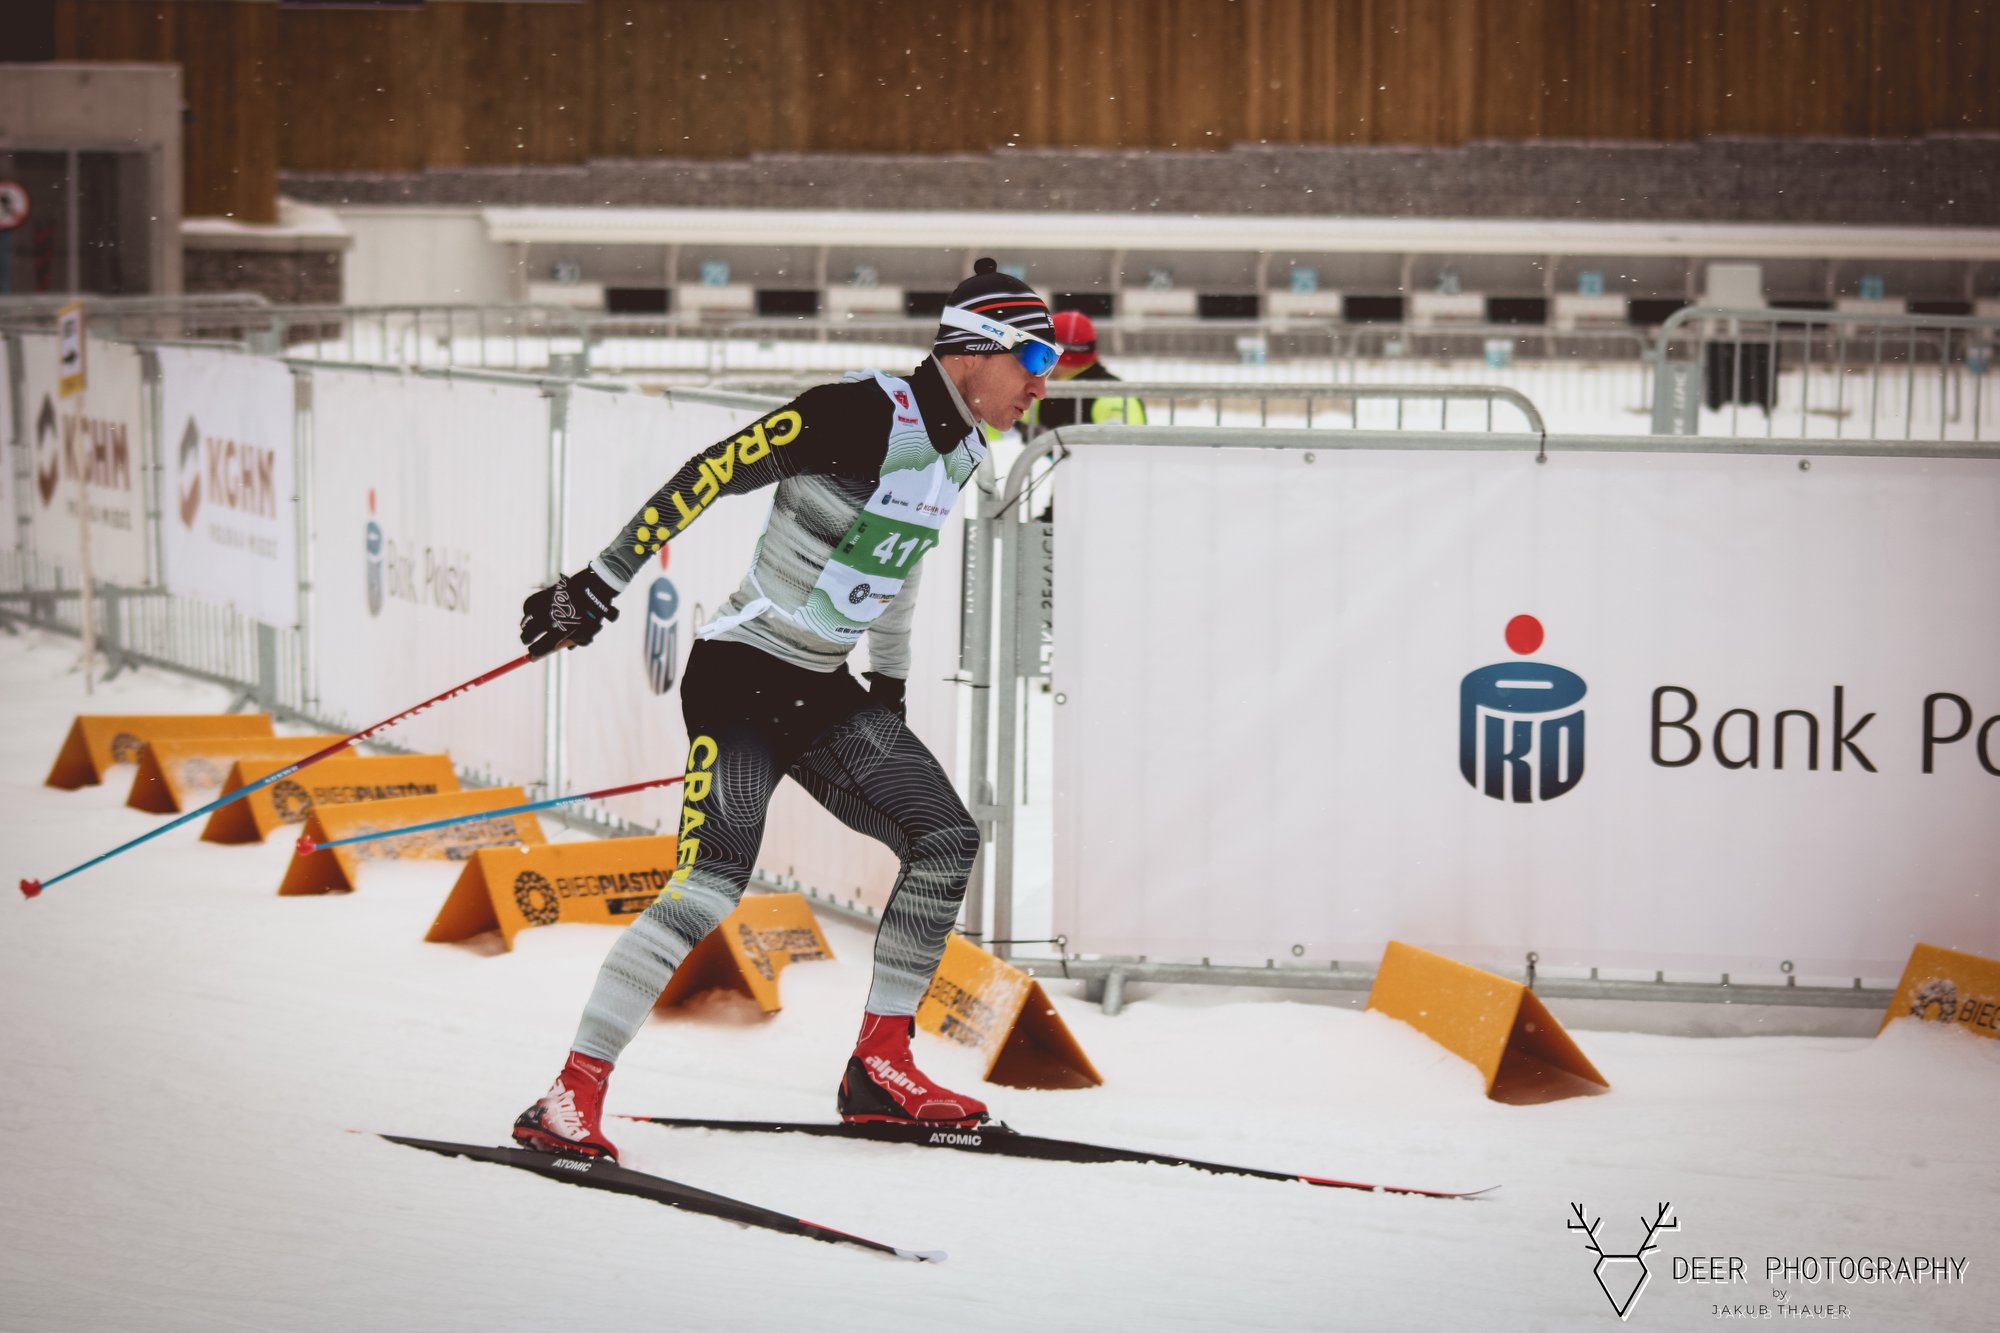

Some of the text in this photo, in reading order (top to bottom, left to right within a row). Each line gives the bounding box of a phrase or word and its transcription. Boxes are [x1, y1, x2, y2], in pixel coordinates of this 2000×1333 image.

[671, 410, 802, 530] CRAFT
[1650, 684, 1879, 774] Bank
[865, 1055, 928, 1096] alpina
[929, 1132, 982, 1146] ATOMIC
[551, 1158, 592, 1172] ATOMIC
